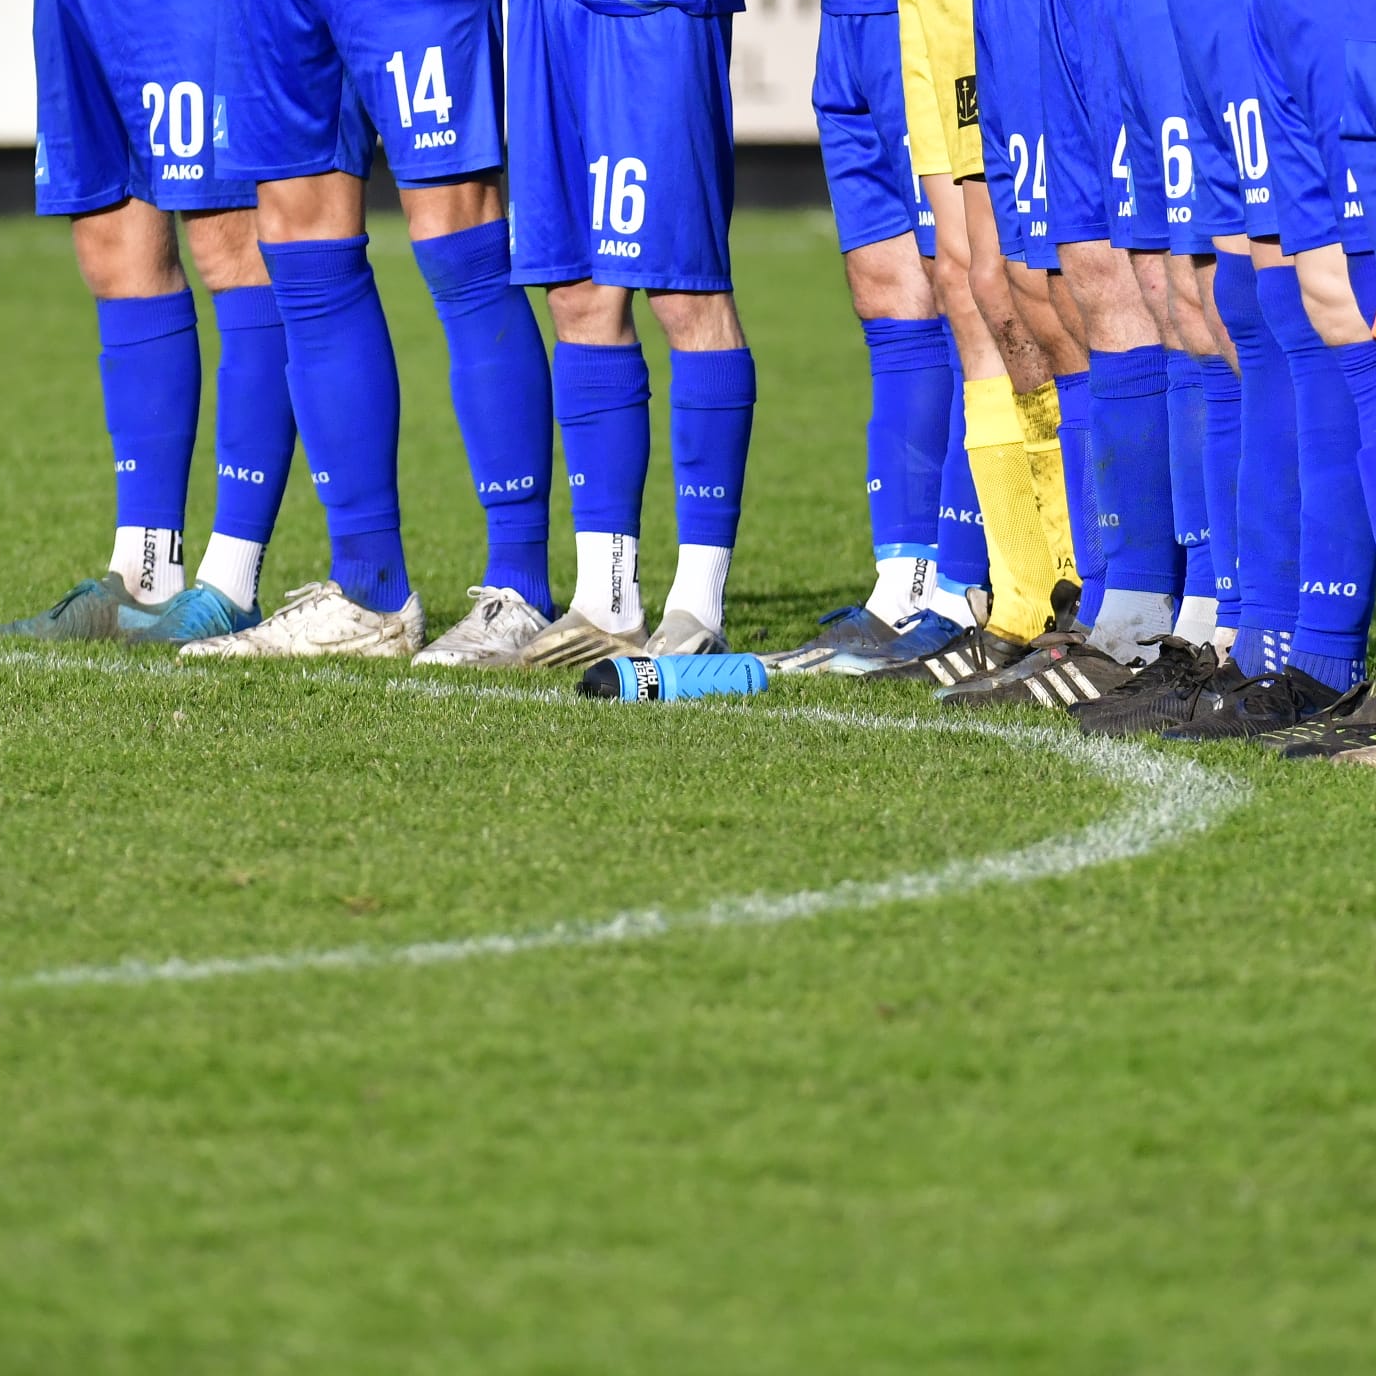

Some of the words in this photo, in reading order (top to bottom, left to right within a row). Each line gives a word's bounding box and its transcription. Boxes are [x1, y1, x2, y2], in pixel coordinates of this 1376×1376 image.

[386, 45, 452, 129] 14
[142, 81, 204, 158] 20
[414, 129, 457, 150] JAKO
[1223, 98, 1269, 180] 10
[1161, 116, 1193, 200] 6
[161, 163, 204, 181] JAKO
[1009, 132, 1047, 214] 24
[589, 155, 647, 235] 16
[918, 209, 936, 227] JAK
[597, 239, 641, 258] JAKO
[217, 463, 265, 485] JAKO
[478, 475, 535, 493] JAKO
[678, 484, 725, 499] JAKO
[1300, 580, 1357, 597] JAKO
[633, 659, 650, 704] OWER
